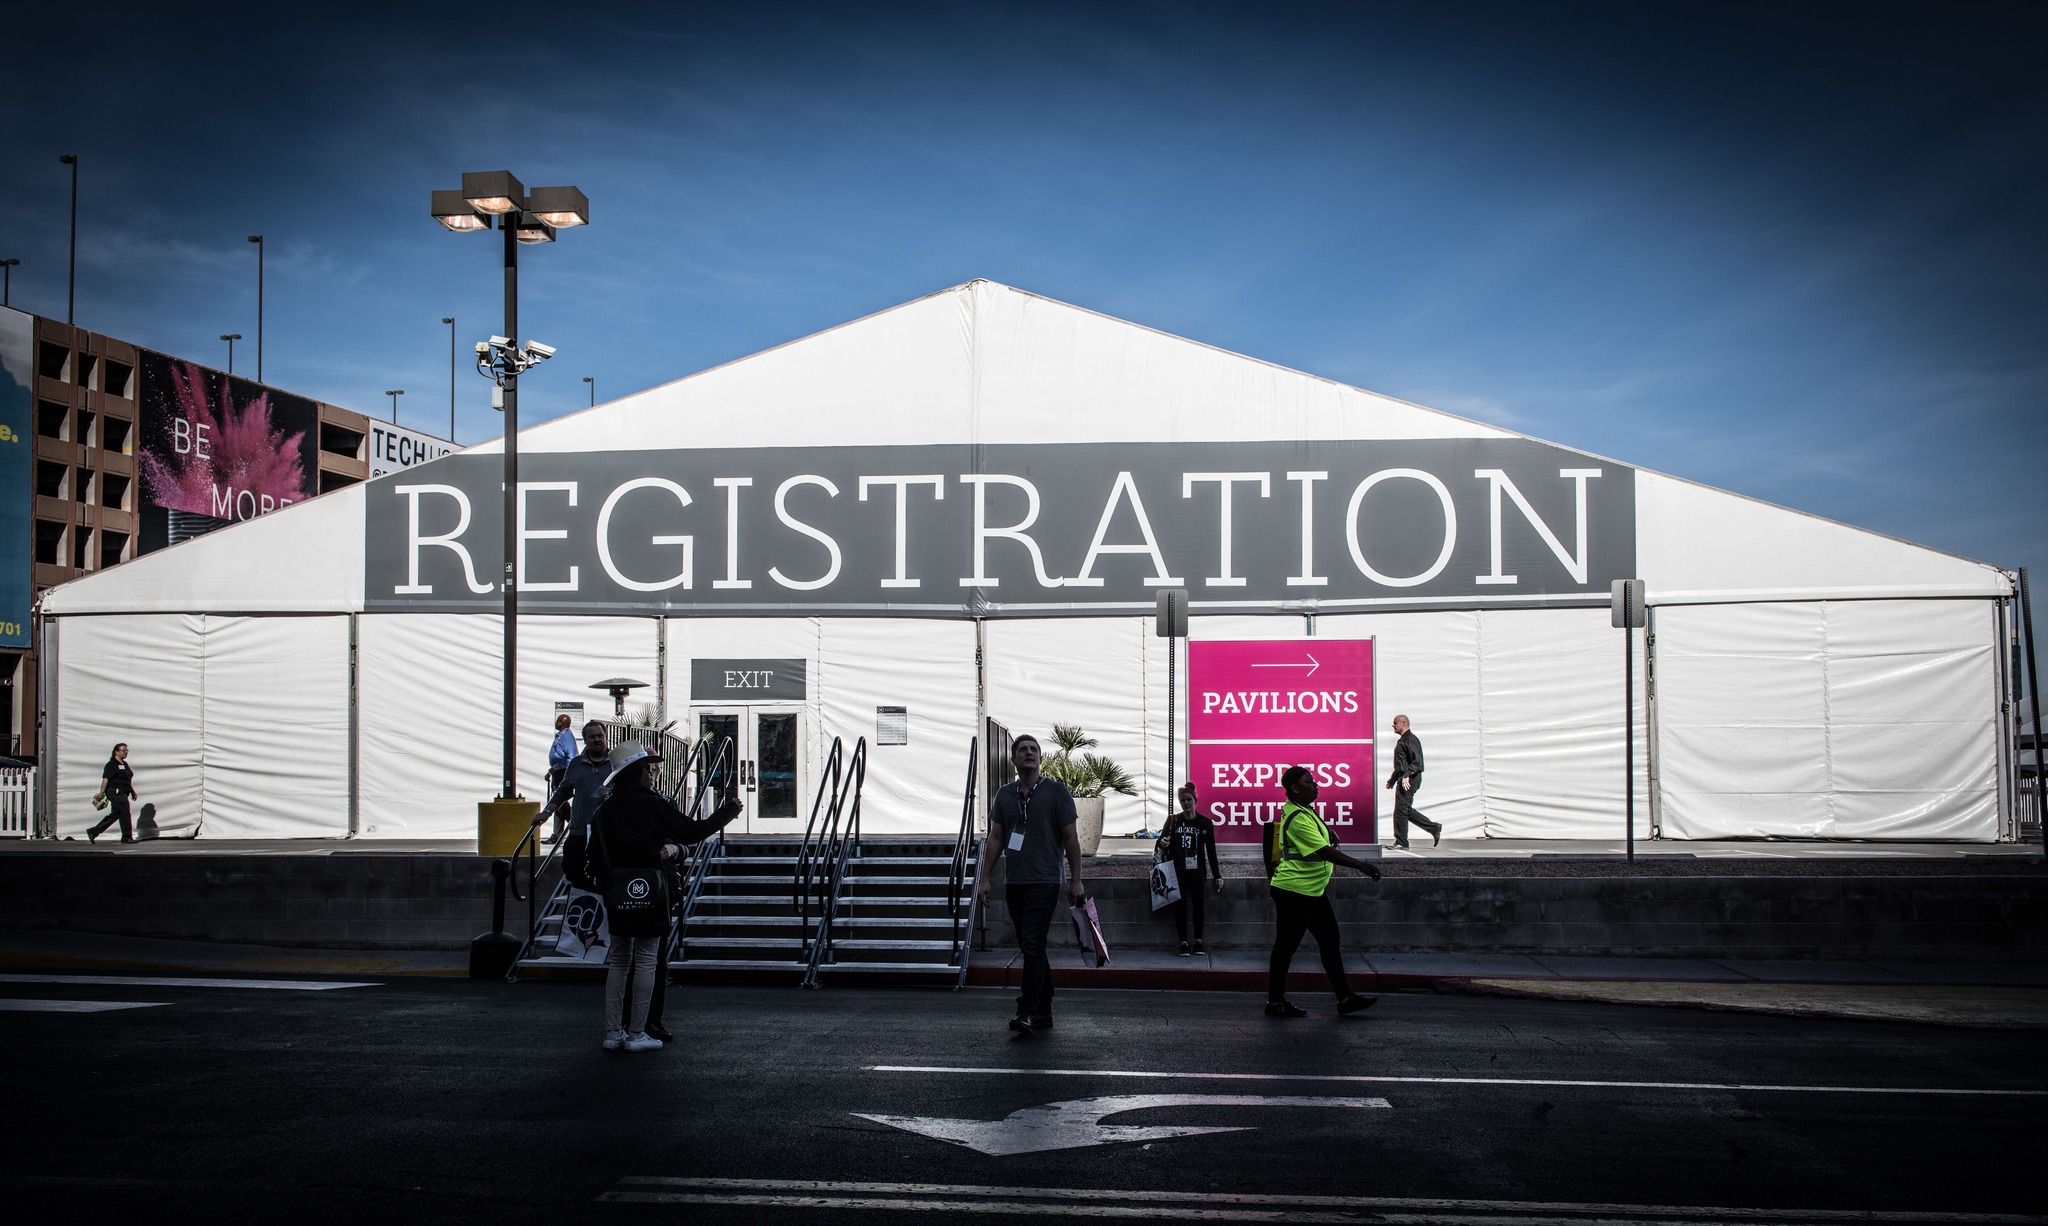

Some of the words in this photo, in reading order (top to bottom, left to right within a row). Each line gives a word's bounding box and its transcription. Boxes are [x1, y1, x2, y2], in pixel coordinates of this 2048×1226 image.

[174, 417, 211, 460] BE
[373, 427, 425, 467] TECH
[212, 483, 293, 521] MOR
[394, 468, 1603, 595] REGISTRATION
[724, 670, 774, 688] EXIT
[1202, 690, 1359, 714] PAVILIONS
[1211, 762, 1351, 788] EXPSS
[1210, 801, 1354, 826] SHULE
